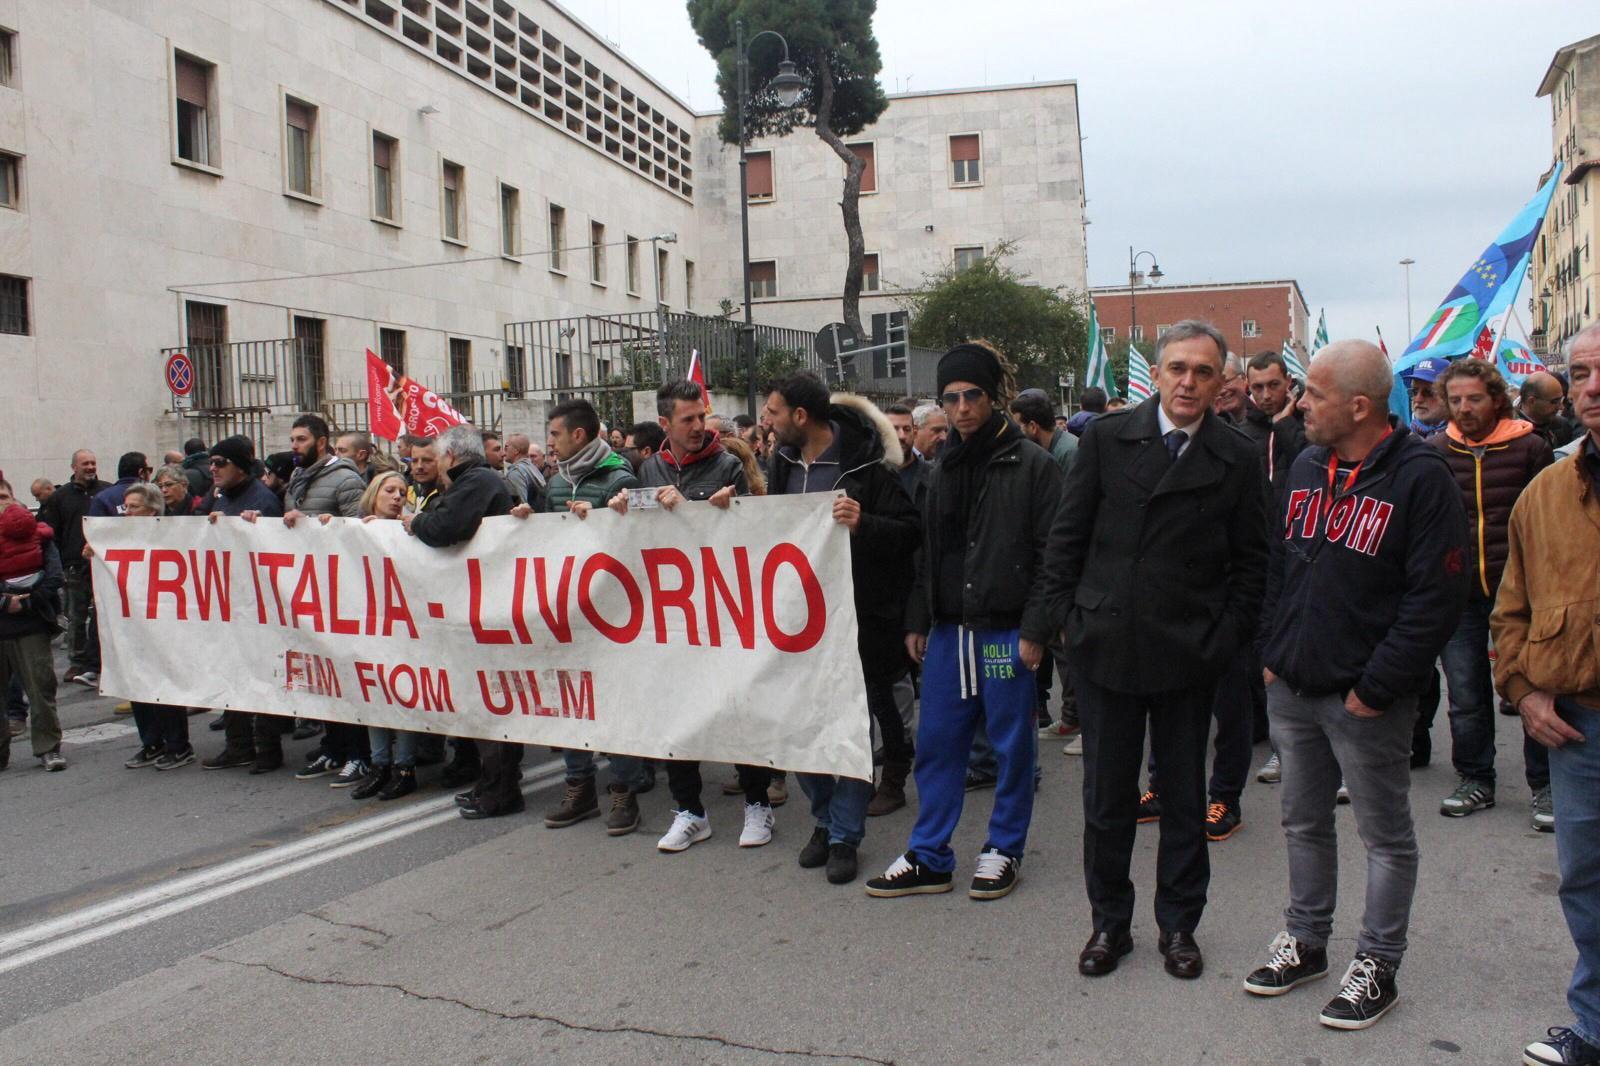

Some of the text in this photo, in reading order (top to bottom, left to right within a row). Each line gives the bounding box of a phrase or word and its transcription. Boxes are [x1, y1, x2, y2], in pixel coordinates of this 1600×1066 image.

[1419, 360, 1433, 369] UIL
[1285, 488, 1394, 557] FIOM
[106, 542, 827, 653] TRW ITALIA - LIVORNO
[982, 643, 1012, 658] HOLLI
[984, 664, 1016, 679] STER
[285, 649, 596, 722] FIM FIOM UILM
